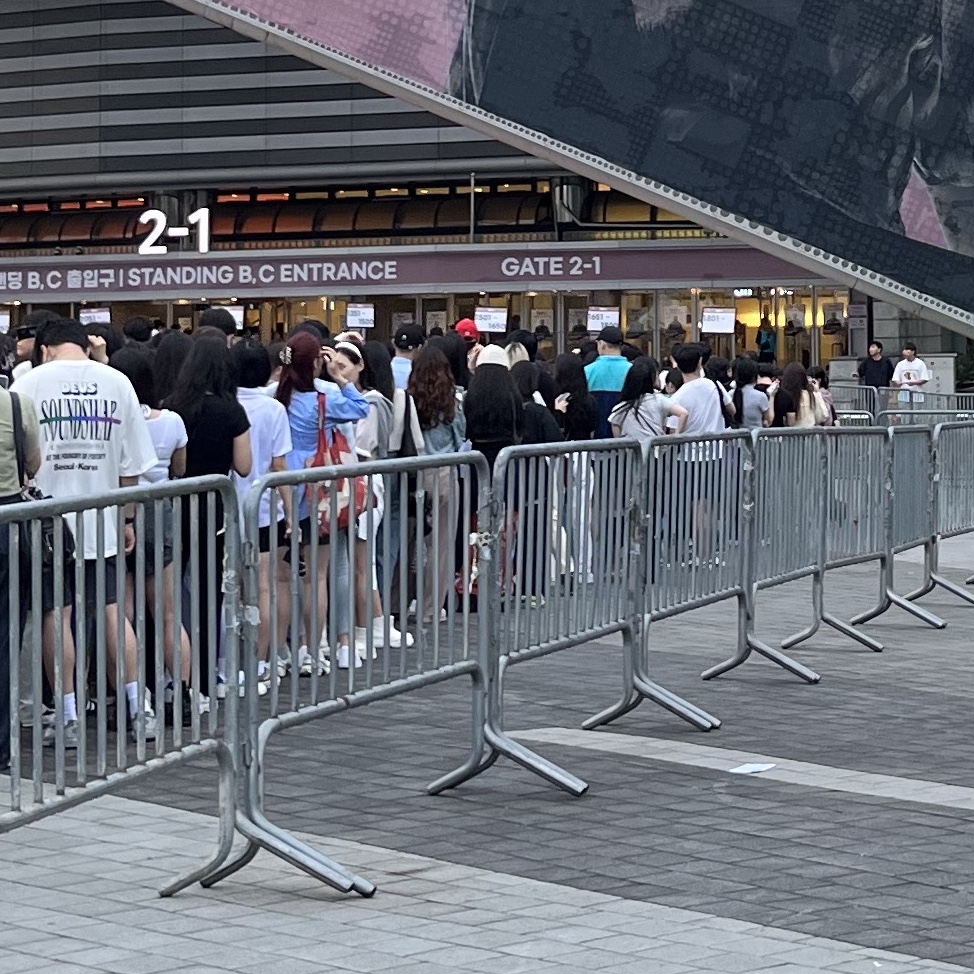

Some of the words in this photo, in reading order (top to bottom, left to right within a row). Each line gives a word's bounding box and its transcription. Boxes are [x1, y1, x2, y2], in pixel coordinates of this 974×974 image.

[138, 207, 210, 255] 2-1
[27, 270, 62, 290] B,C
[66, 268, 116, 289] 출입구
[127, 264, 234, 288] STANDING
[238, 263, 276, 285] B,C
[279, 260, 398, 283] ENTRANCE
[501, 256, 564, 277] GATE
[569, 255, 601, 275] 2-1
[61, 382, 98, 396] DEUS
